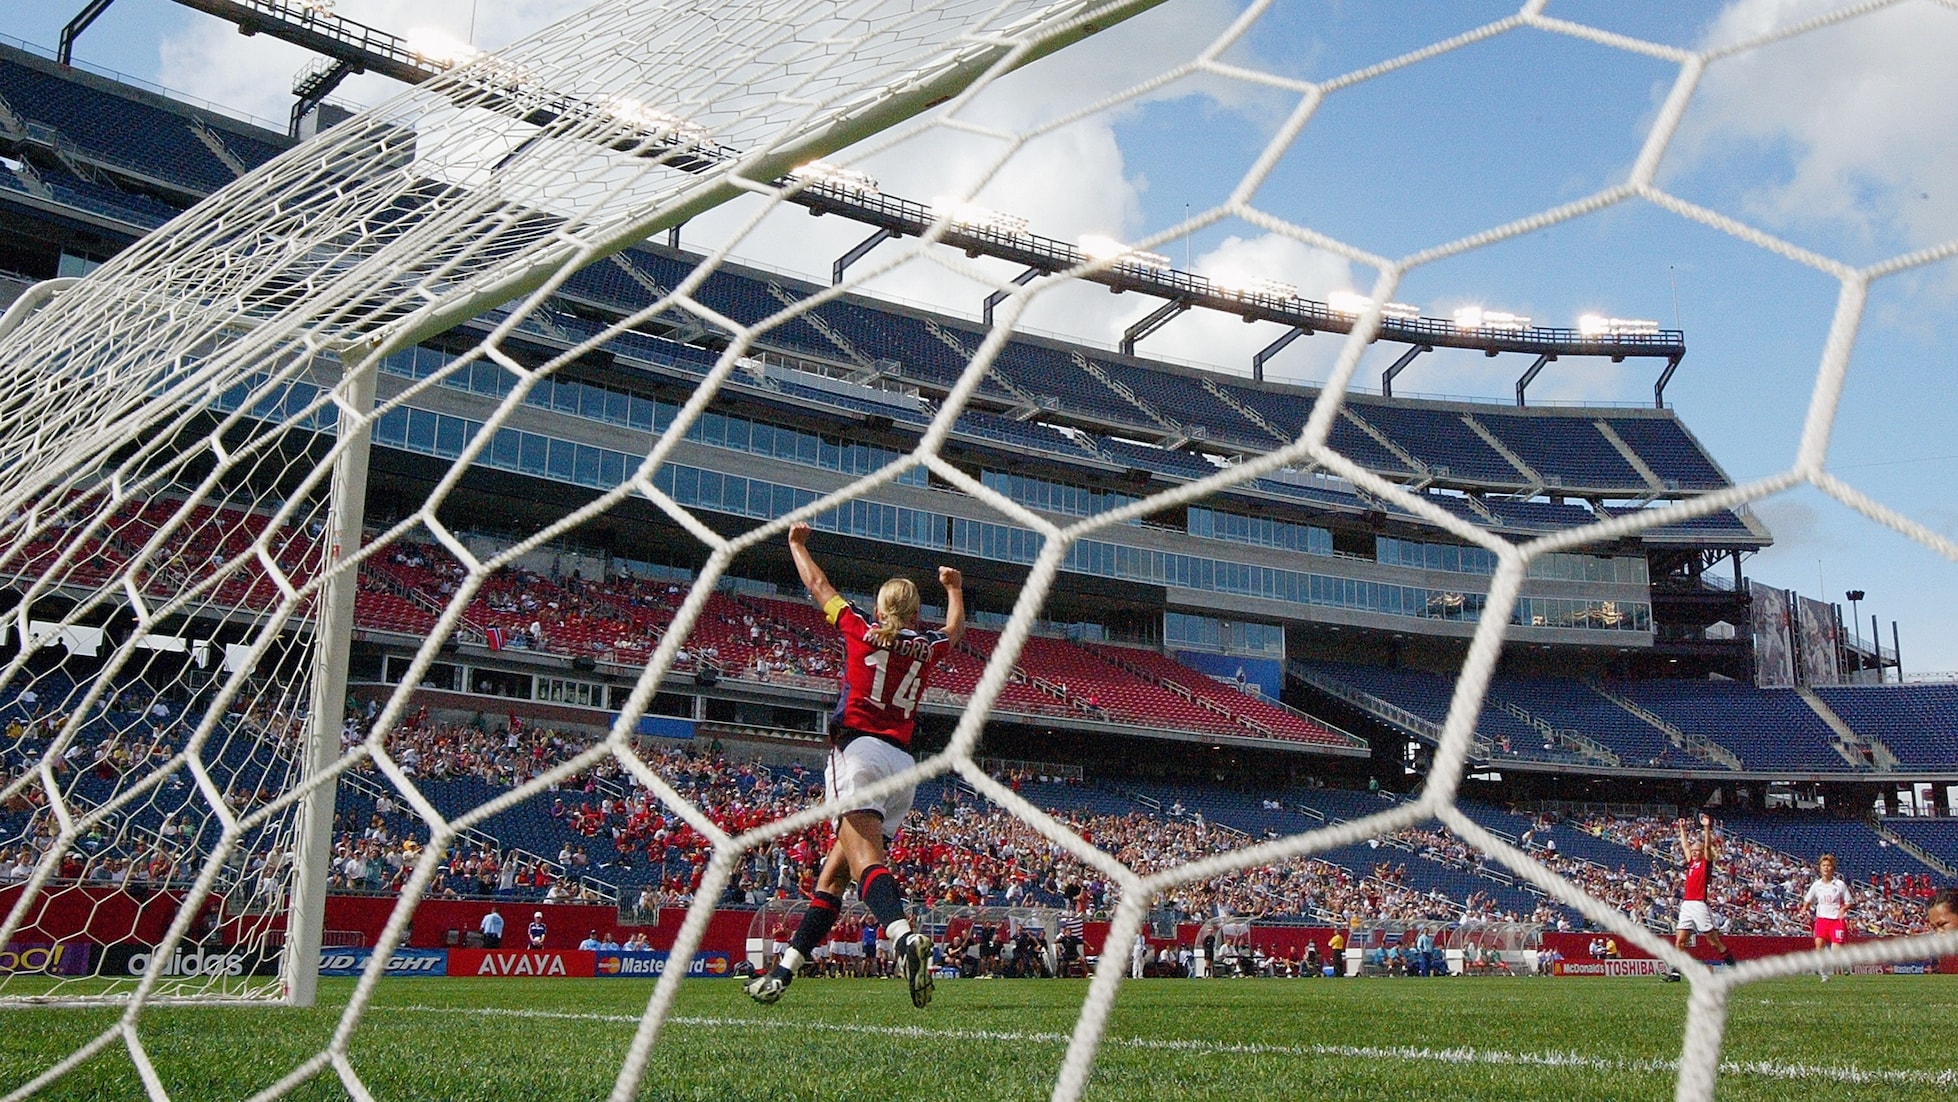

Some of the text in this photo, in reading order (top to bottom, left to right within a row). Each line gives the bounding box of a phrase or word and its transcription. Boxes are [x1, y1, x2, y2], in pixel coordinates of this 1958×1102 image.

[864, 650, 922, 719] 14
[1835, 929, 1844, 939] 10
[318, 955, 355, 969] UD
[478, 953, 566, 975] AVAYA
[621, 957, 704, 973] Masterd
[1606, 961, 1655, 975] TOSHIBA
